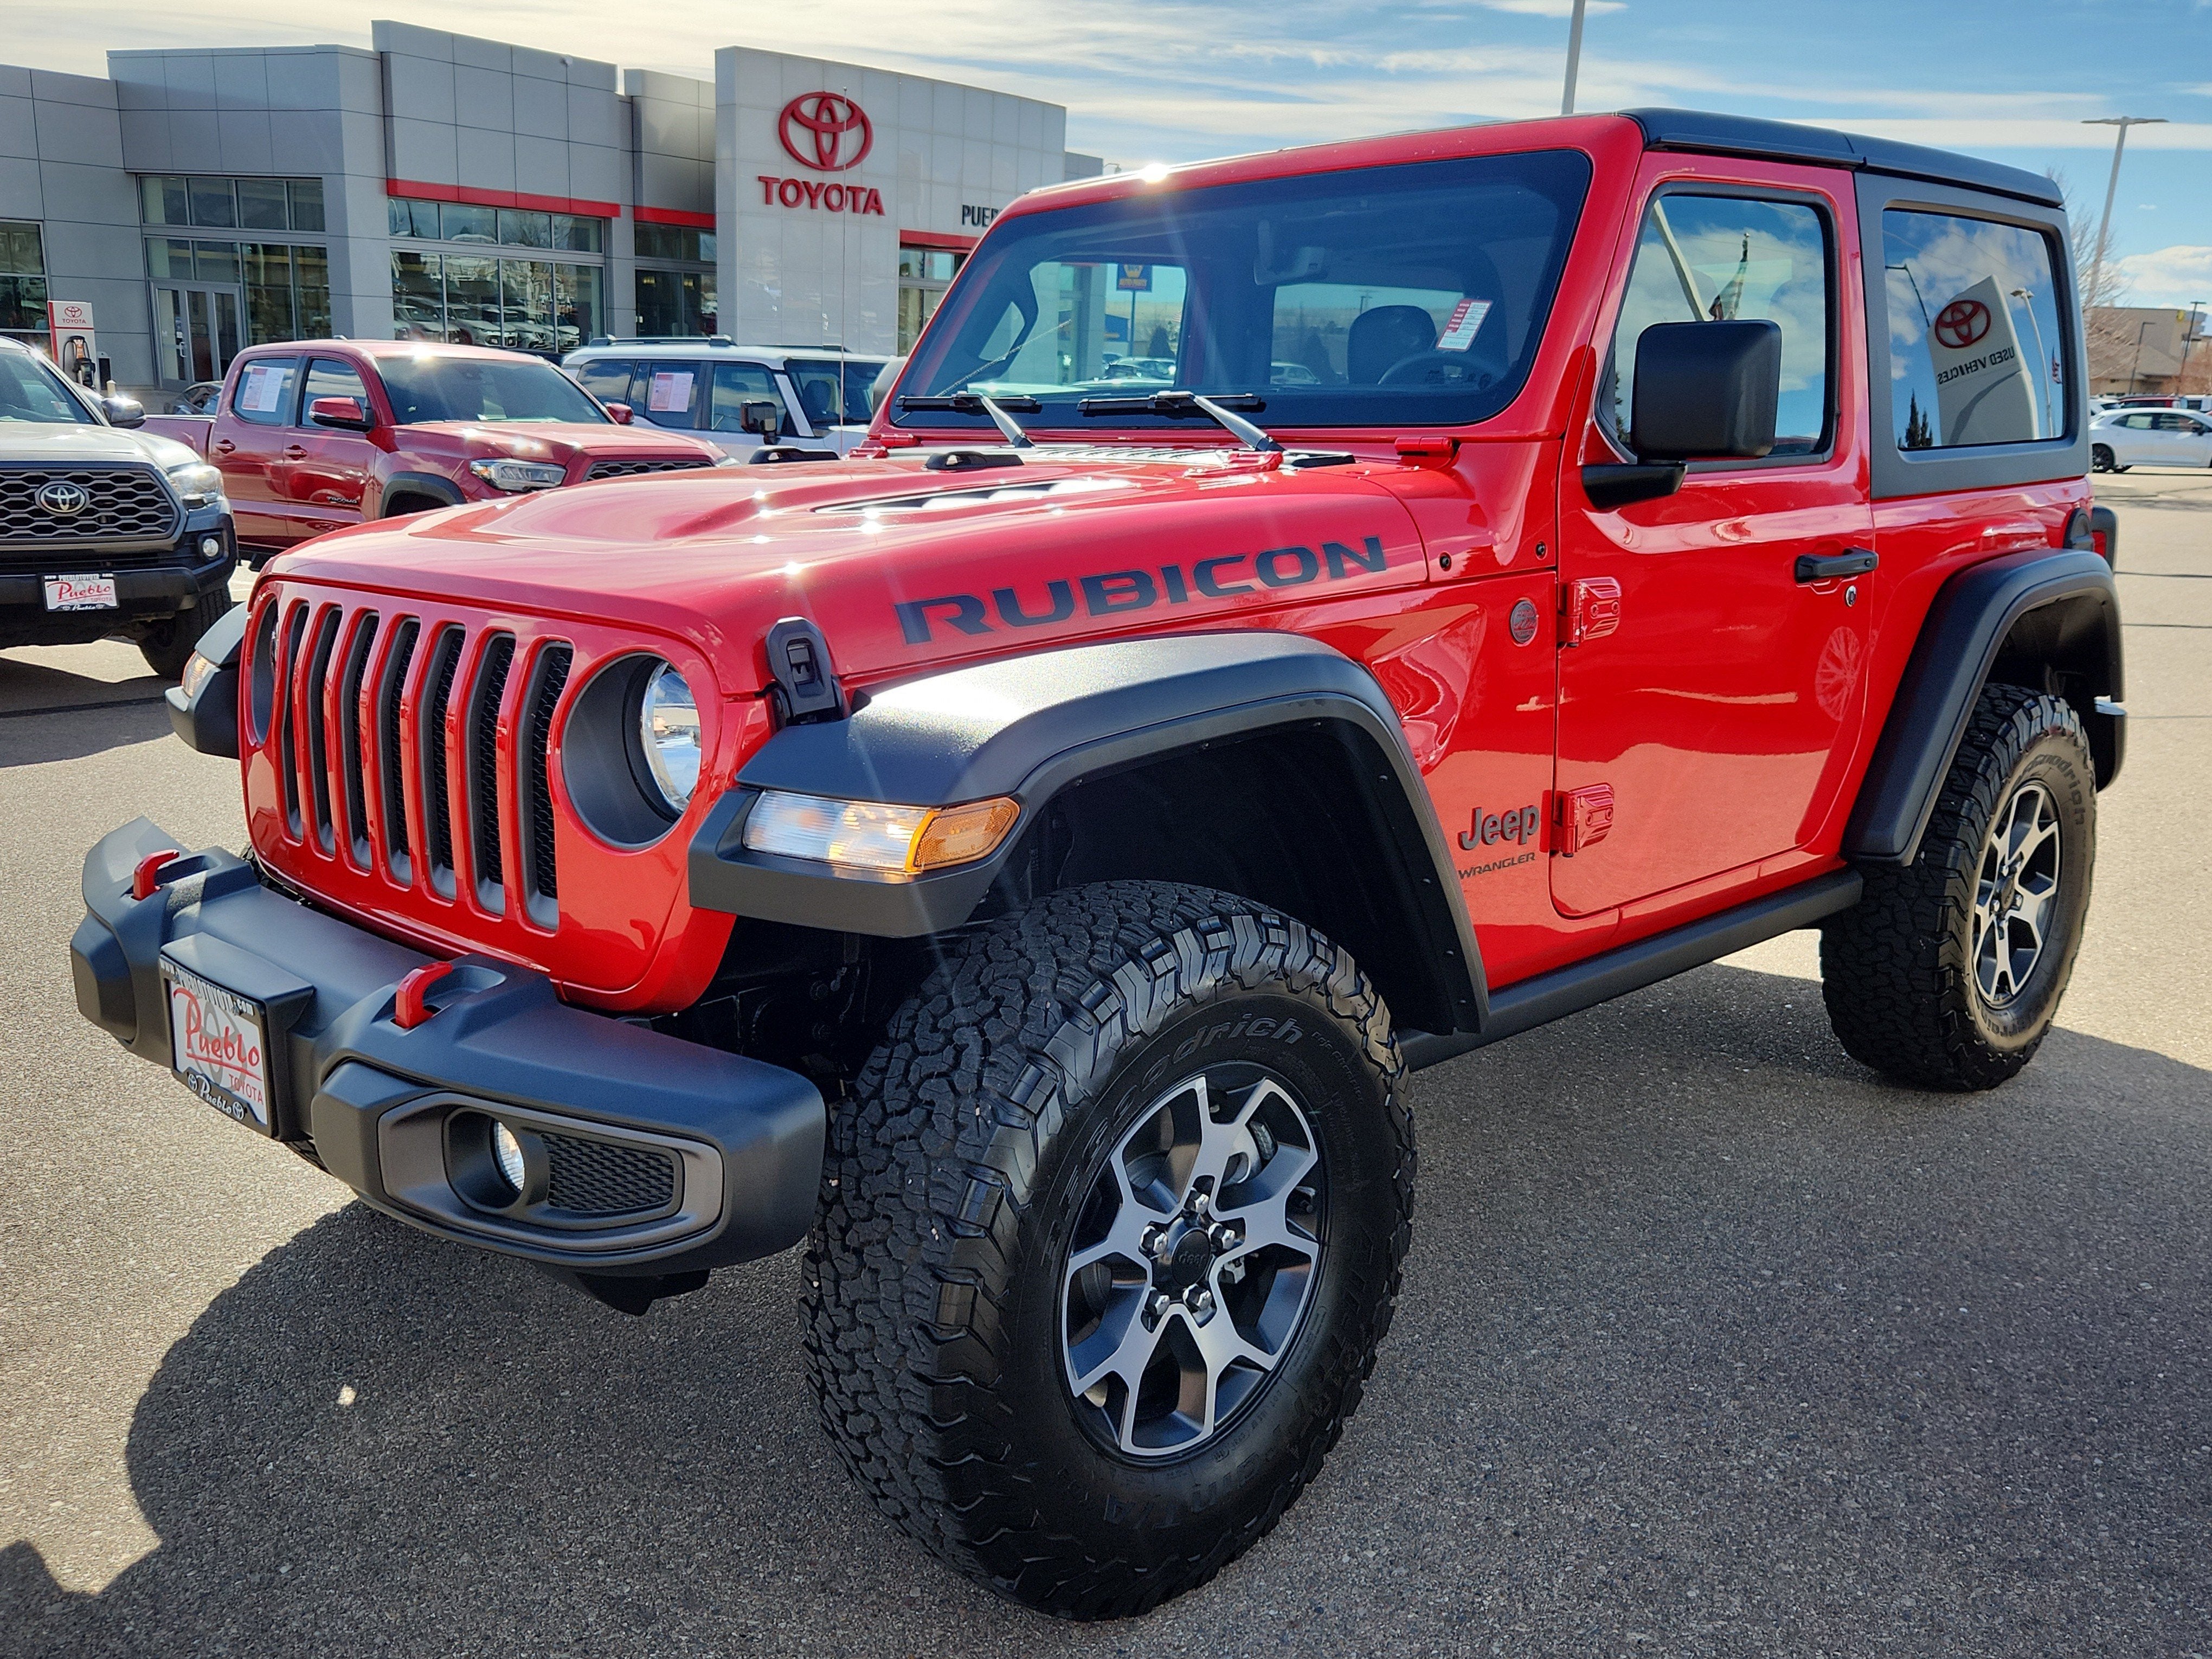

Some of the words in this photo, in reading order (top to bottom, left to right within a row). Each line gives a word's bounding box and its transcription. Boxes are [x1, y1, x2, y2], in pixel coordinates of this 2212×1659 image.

[758, 176, 885, 216] TOYOTA
[47, 582, 111, 600] Pueblo
[895, 536, 1388, 645] RUBICON
[1458, 805, 1540, 851] Jeep
[1458, 852, 1535, 879] WRANGLER
[173, 987, 260, 1066] Pueblo
[196, 1075, 232, 1114] Pueblo
[229, 1074, 263, 1105] TOYOTA
